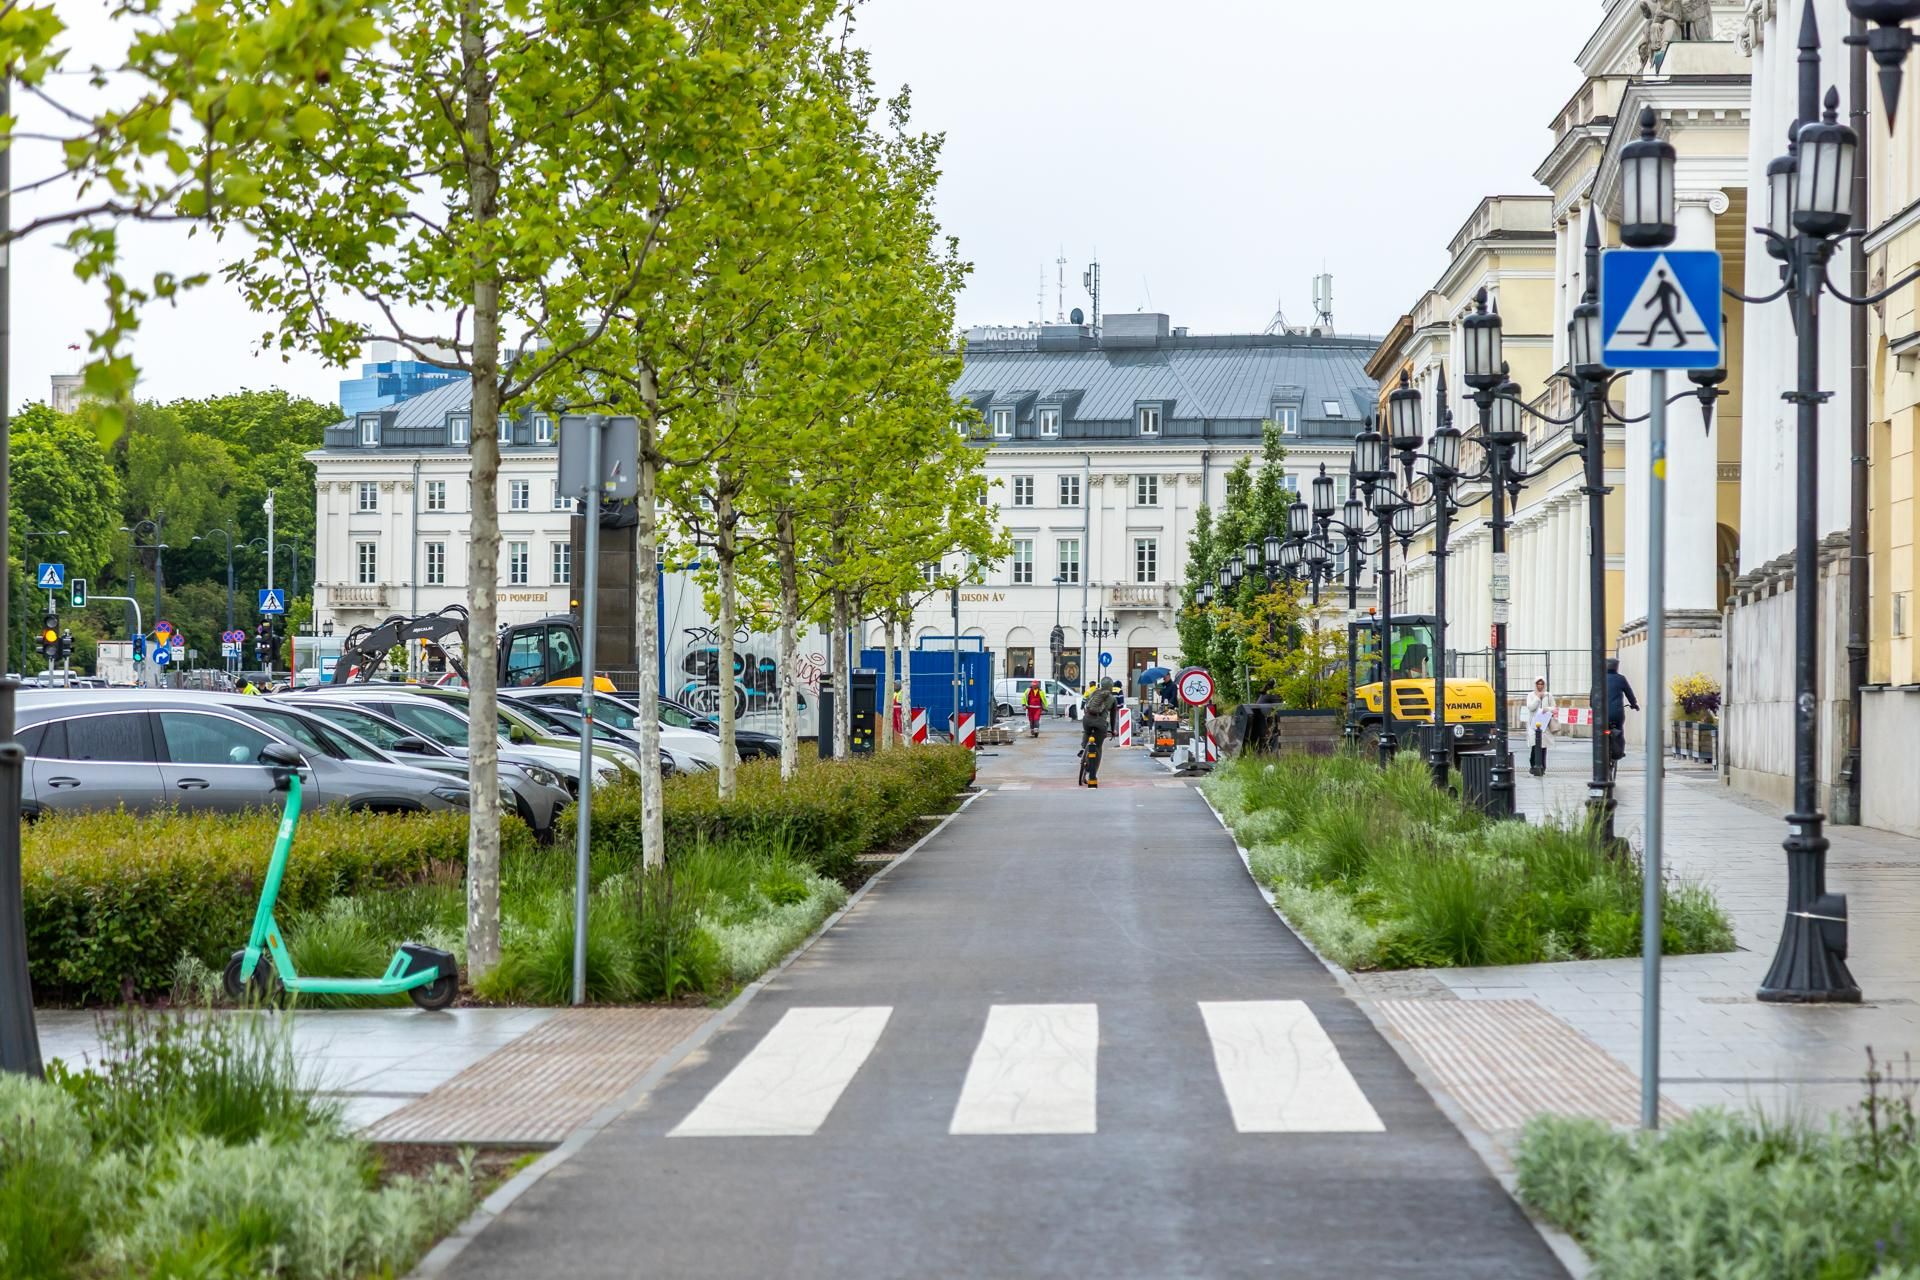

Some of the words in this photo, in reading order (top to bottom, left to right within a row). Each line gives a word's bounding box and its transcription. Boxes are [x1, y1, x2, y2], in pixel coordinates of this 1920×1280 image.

[510, 592, 548, 602] POMPIERI
[945, 592, 989, 602] MDISON
[1456, 726, 1463, 735] 20
